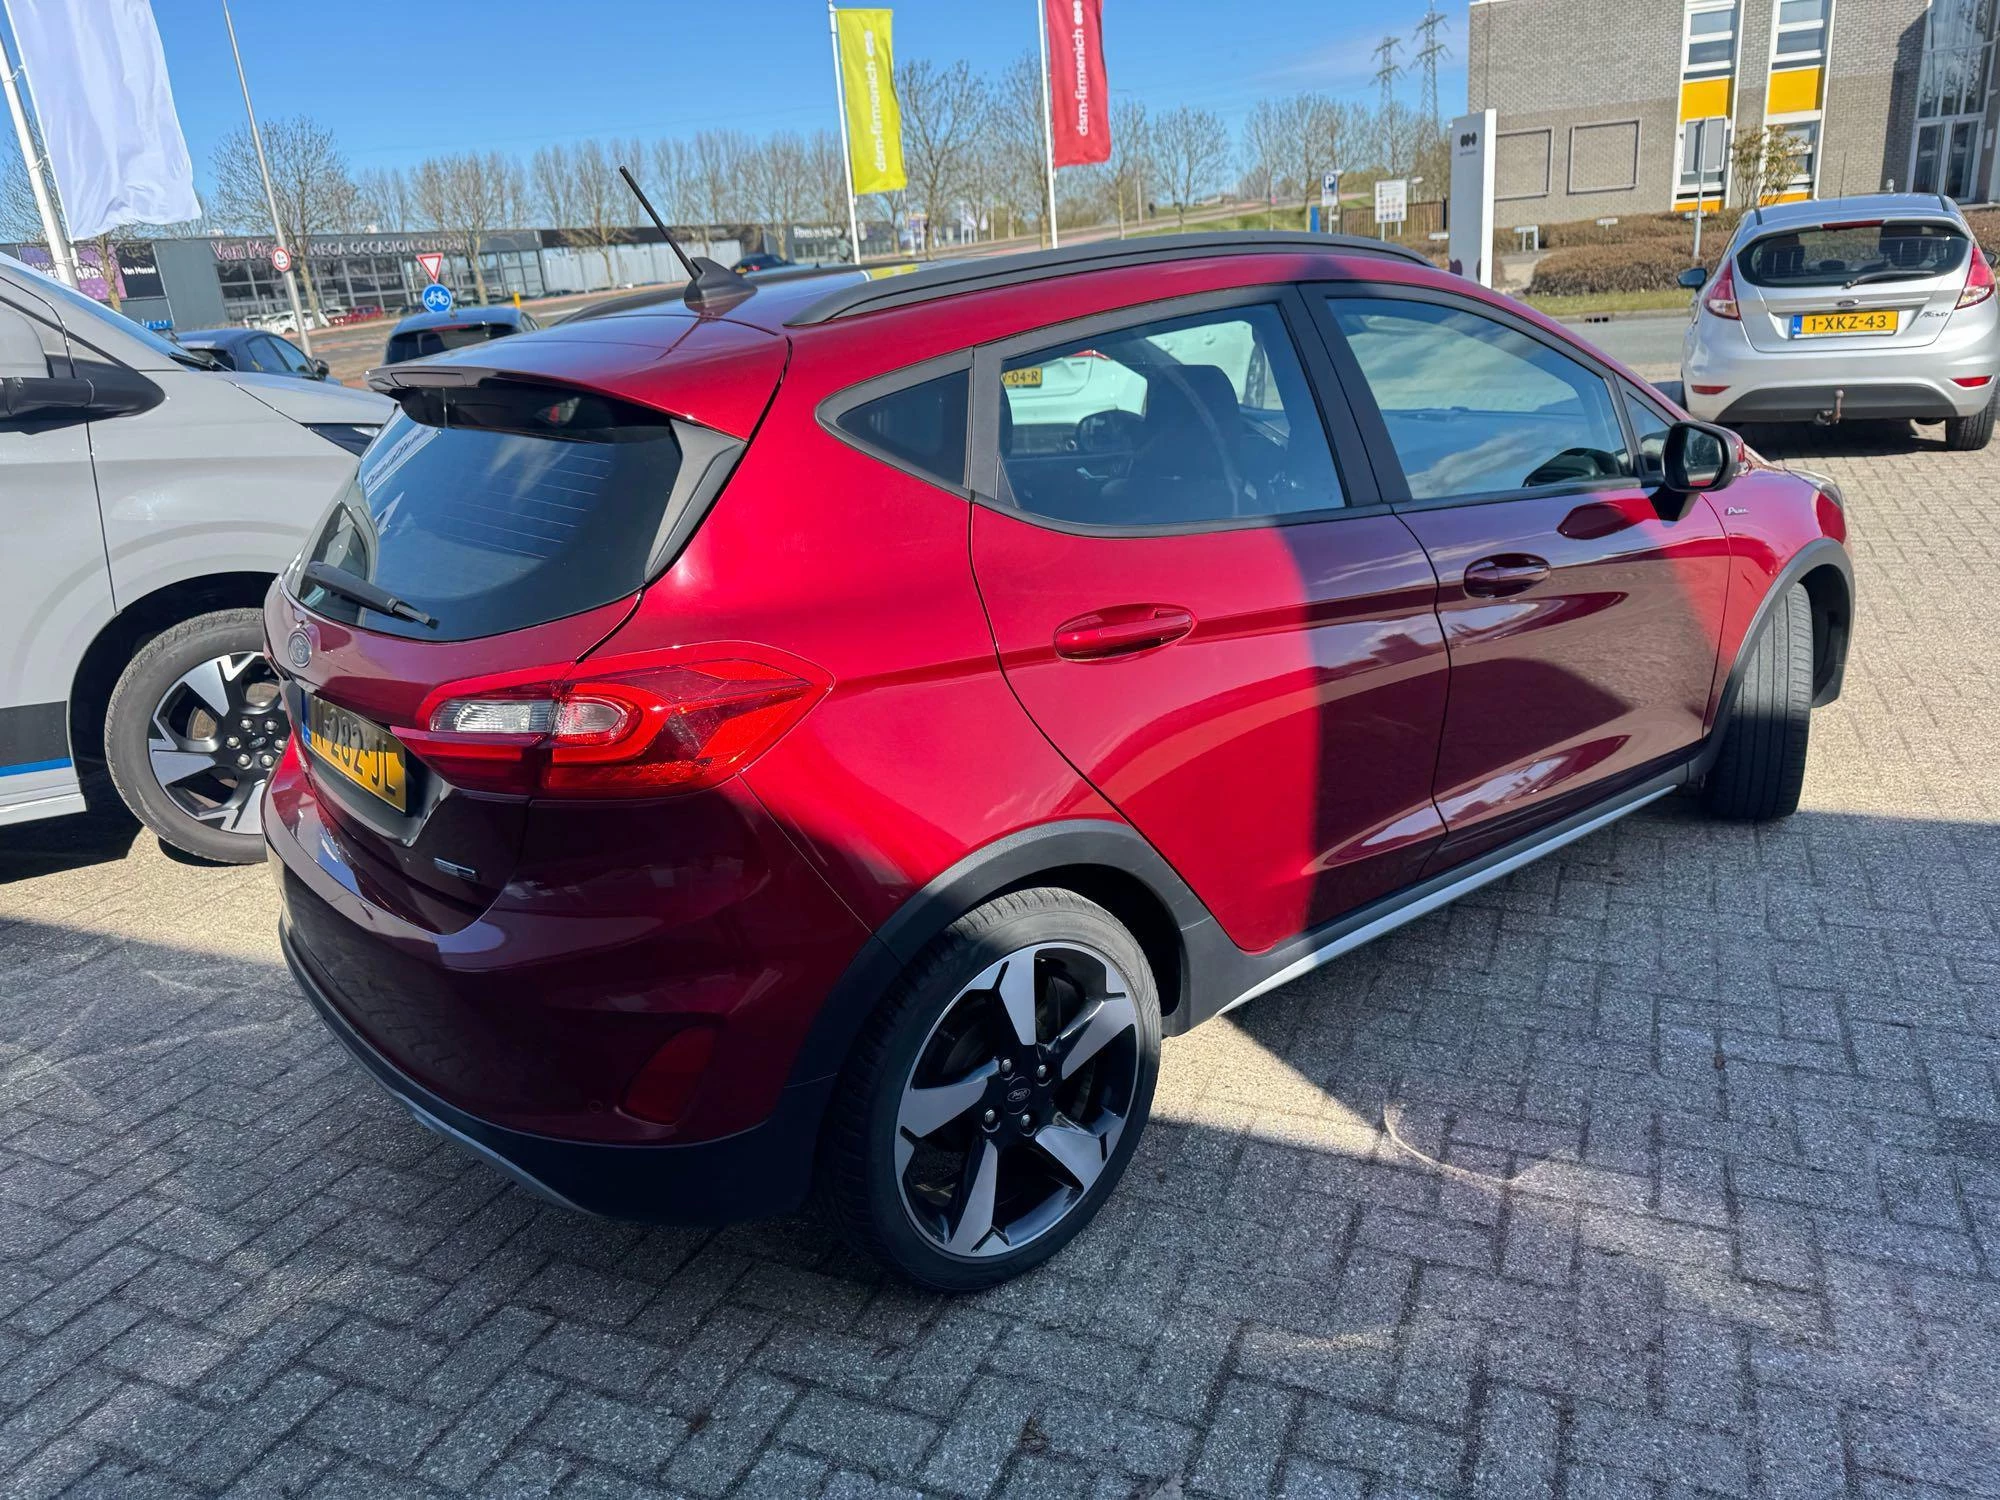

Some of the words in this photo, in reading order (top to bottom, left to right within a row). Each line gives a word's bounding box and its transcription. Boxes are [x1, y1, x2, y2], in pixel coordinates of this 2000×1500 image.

[1072, 28, 1088, 136] dsm-firmenich
[211, 240, 246, 260] Van
[1811, 315, 1886, 331] 1-XKZ-43
